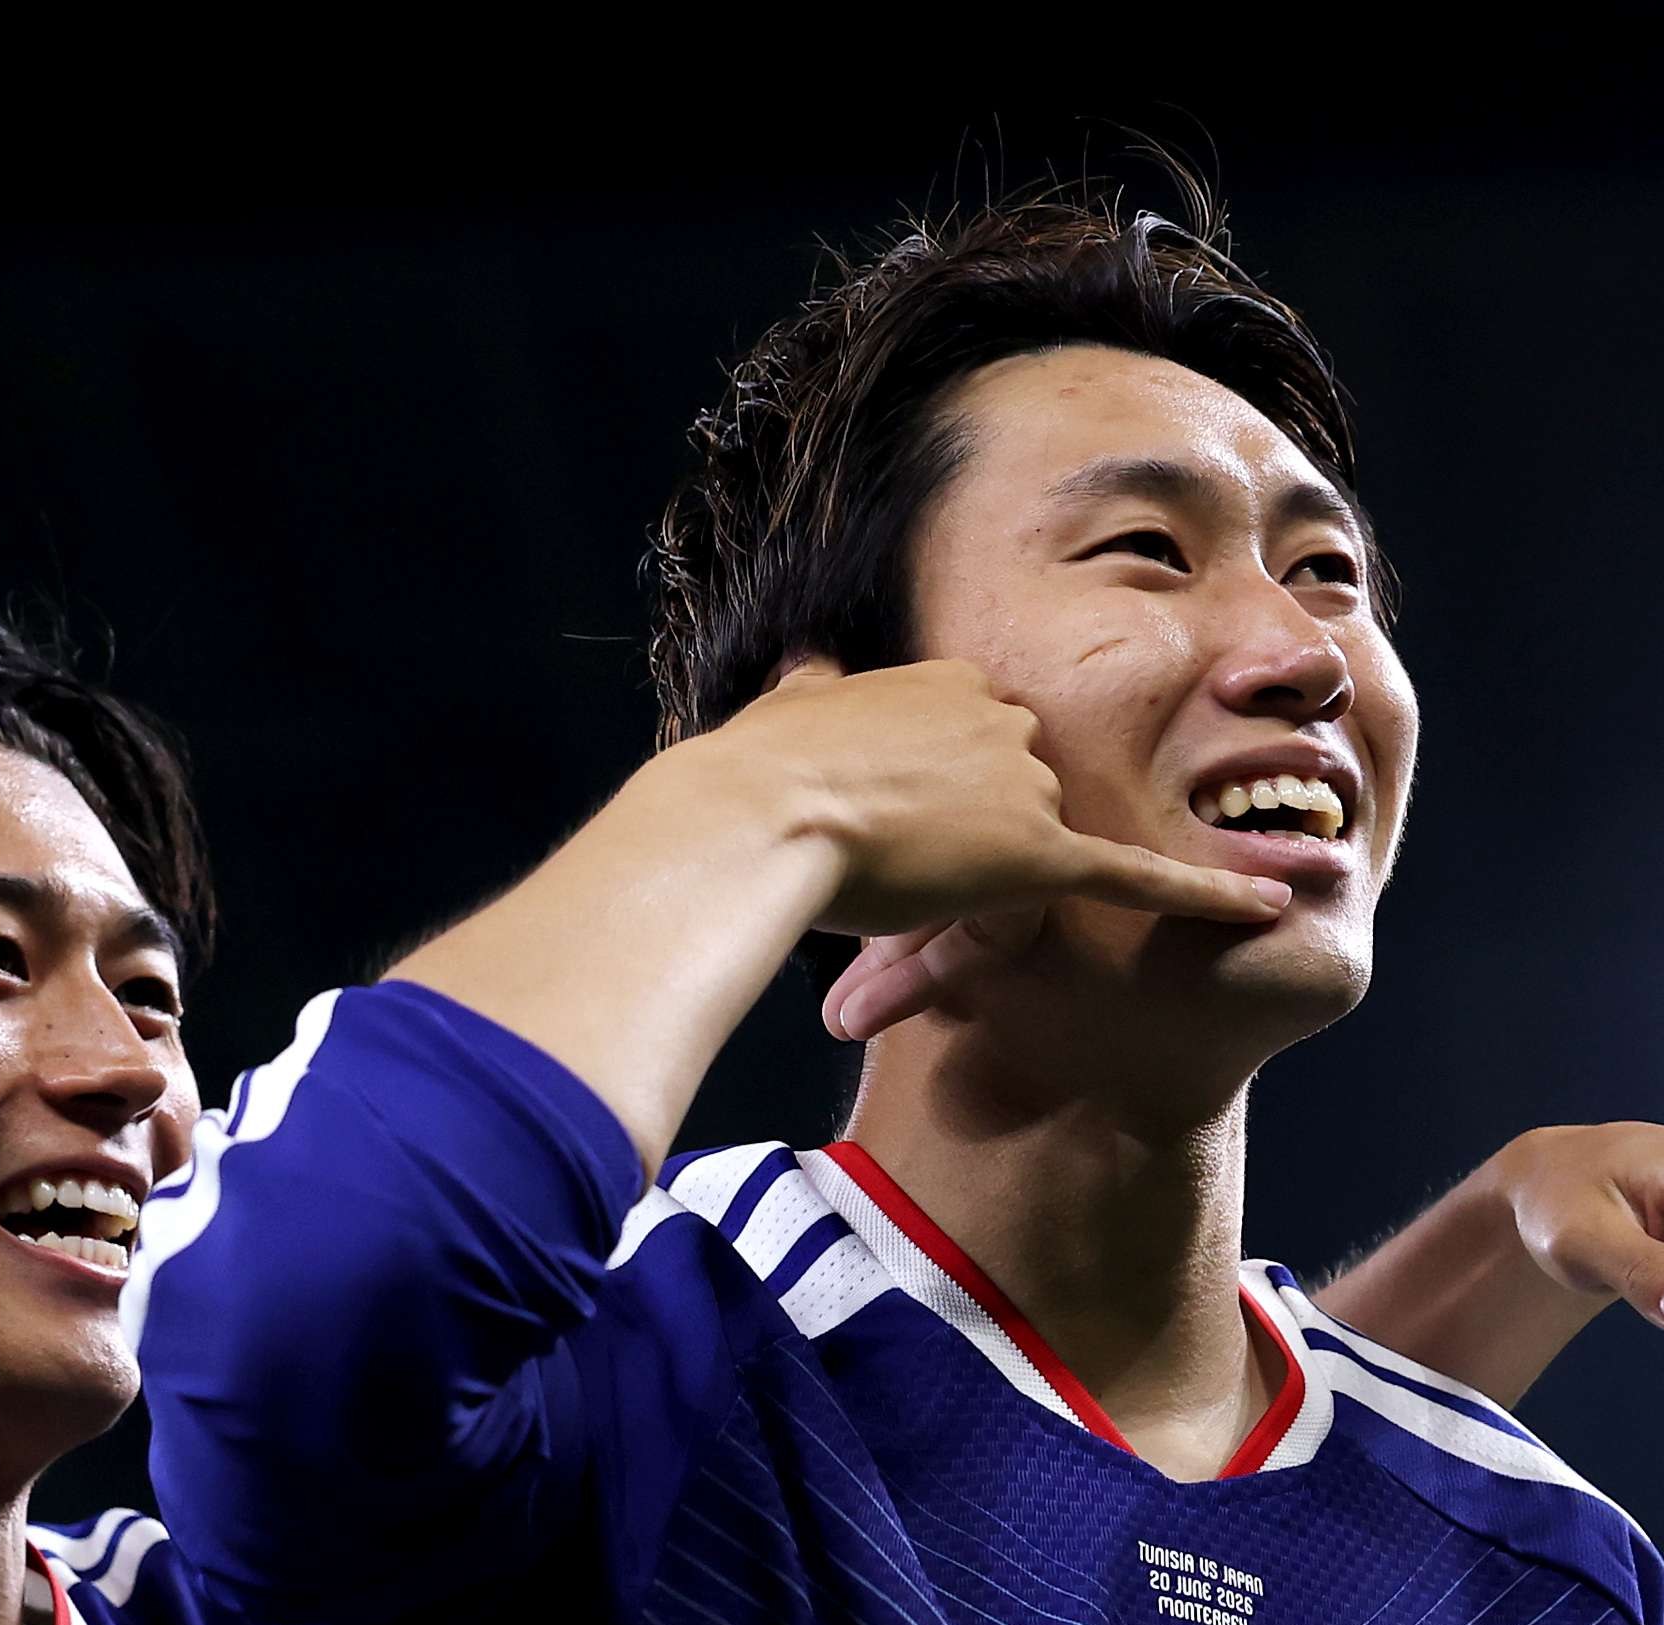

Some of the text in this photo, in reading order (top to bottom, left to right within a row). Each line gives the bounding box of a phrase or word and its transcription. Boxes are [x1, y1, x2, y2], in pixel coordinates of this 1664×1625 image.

[1138, 1540, 1194, 1574] TUNISIA
[1222, 1565, 1264, 1597] JAPAN
[1149, 1570, 1253, 1616] 20 JUNE 2026
